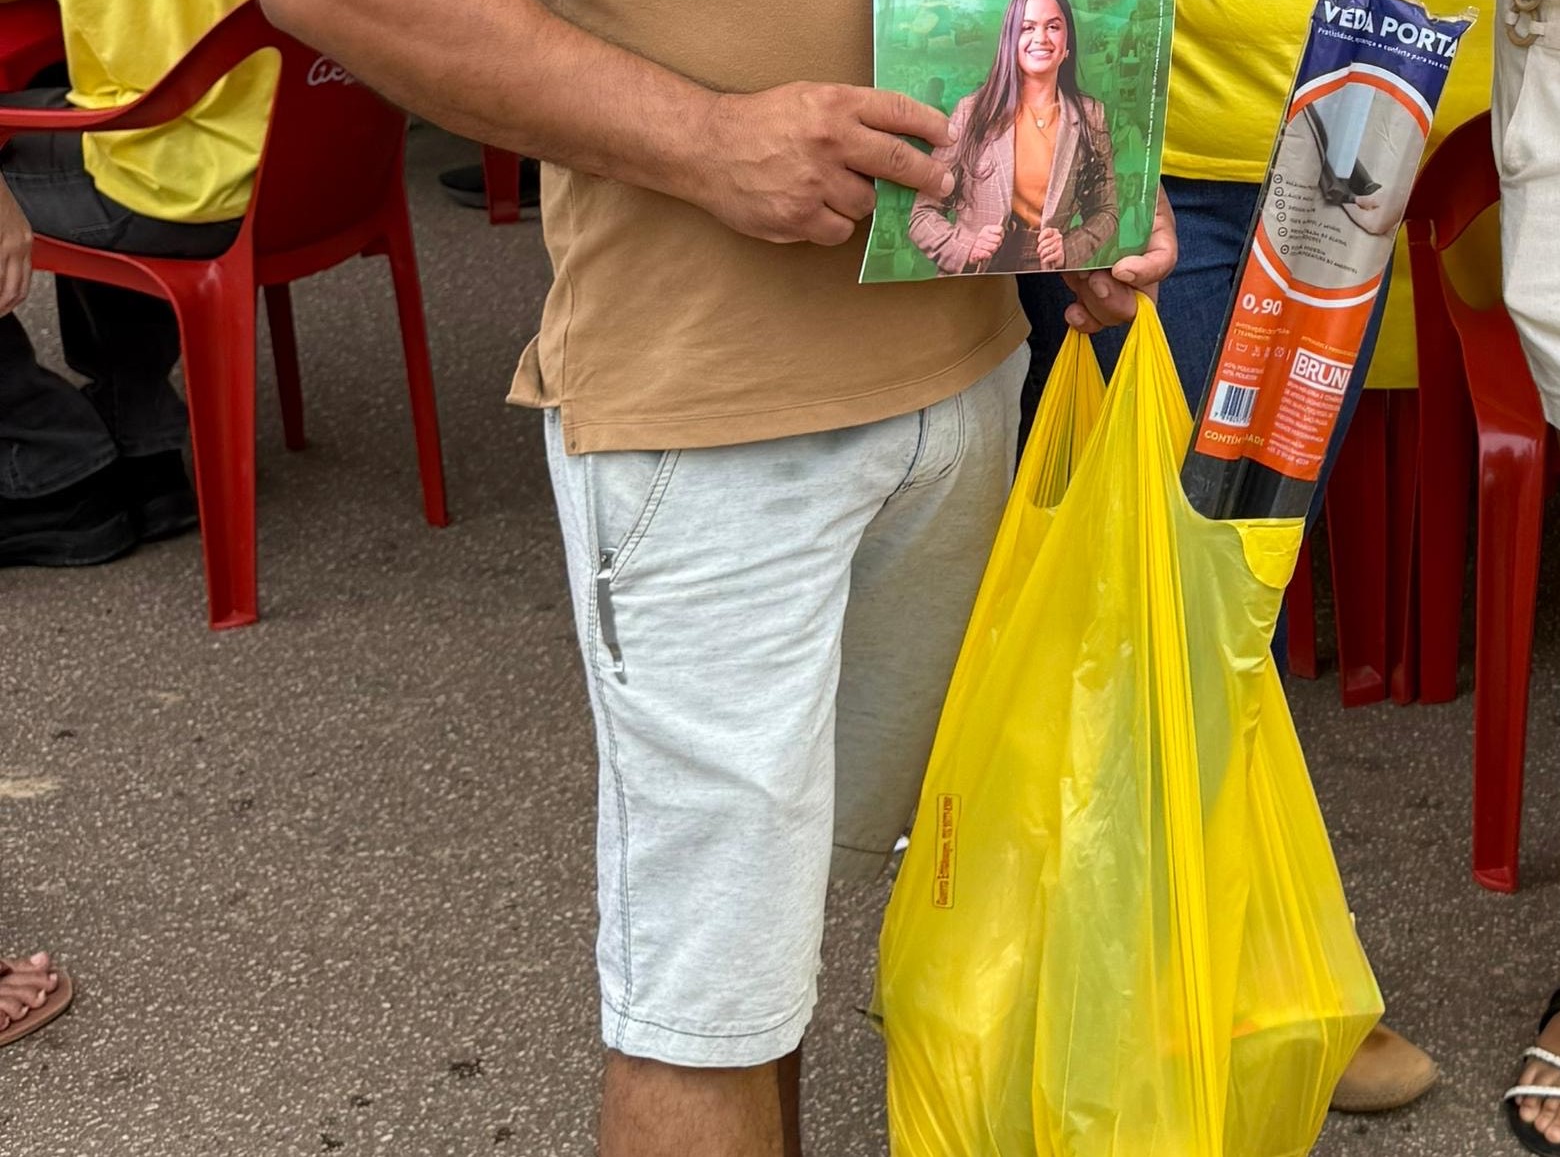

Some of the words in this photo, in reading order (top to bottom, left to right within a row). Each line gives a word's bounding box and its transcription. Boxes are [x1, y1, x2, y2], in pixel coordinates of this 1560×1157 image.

[1324, 0, 1374, 34] VEDA
[1379, 16, 1458, 59] PORTA
[1242, 293, 1282, 316] 0,90
